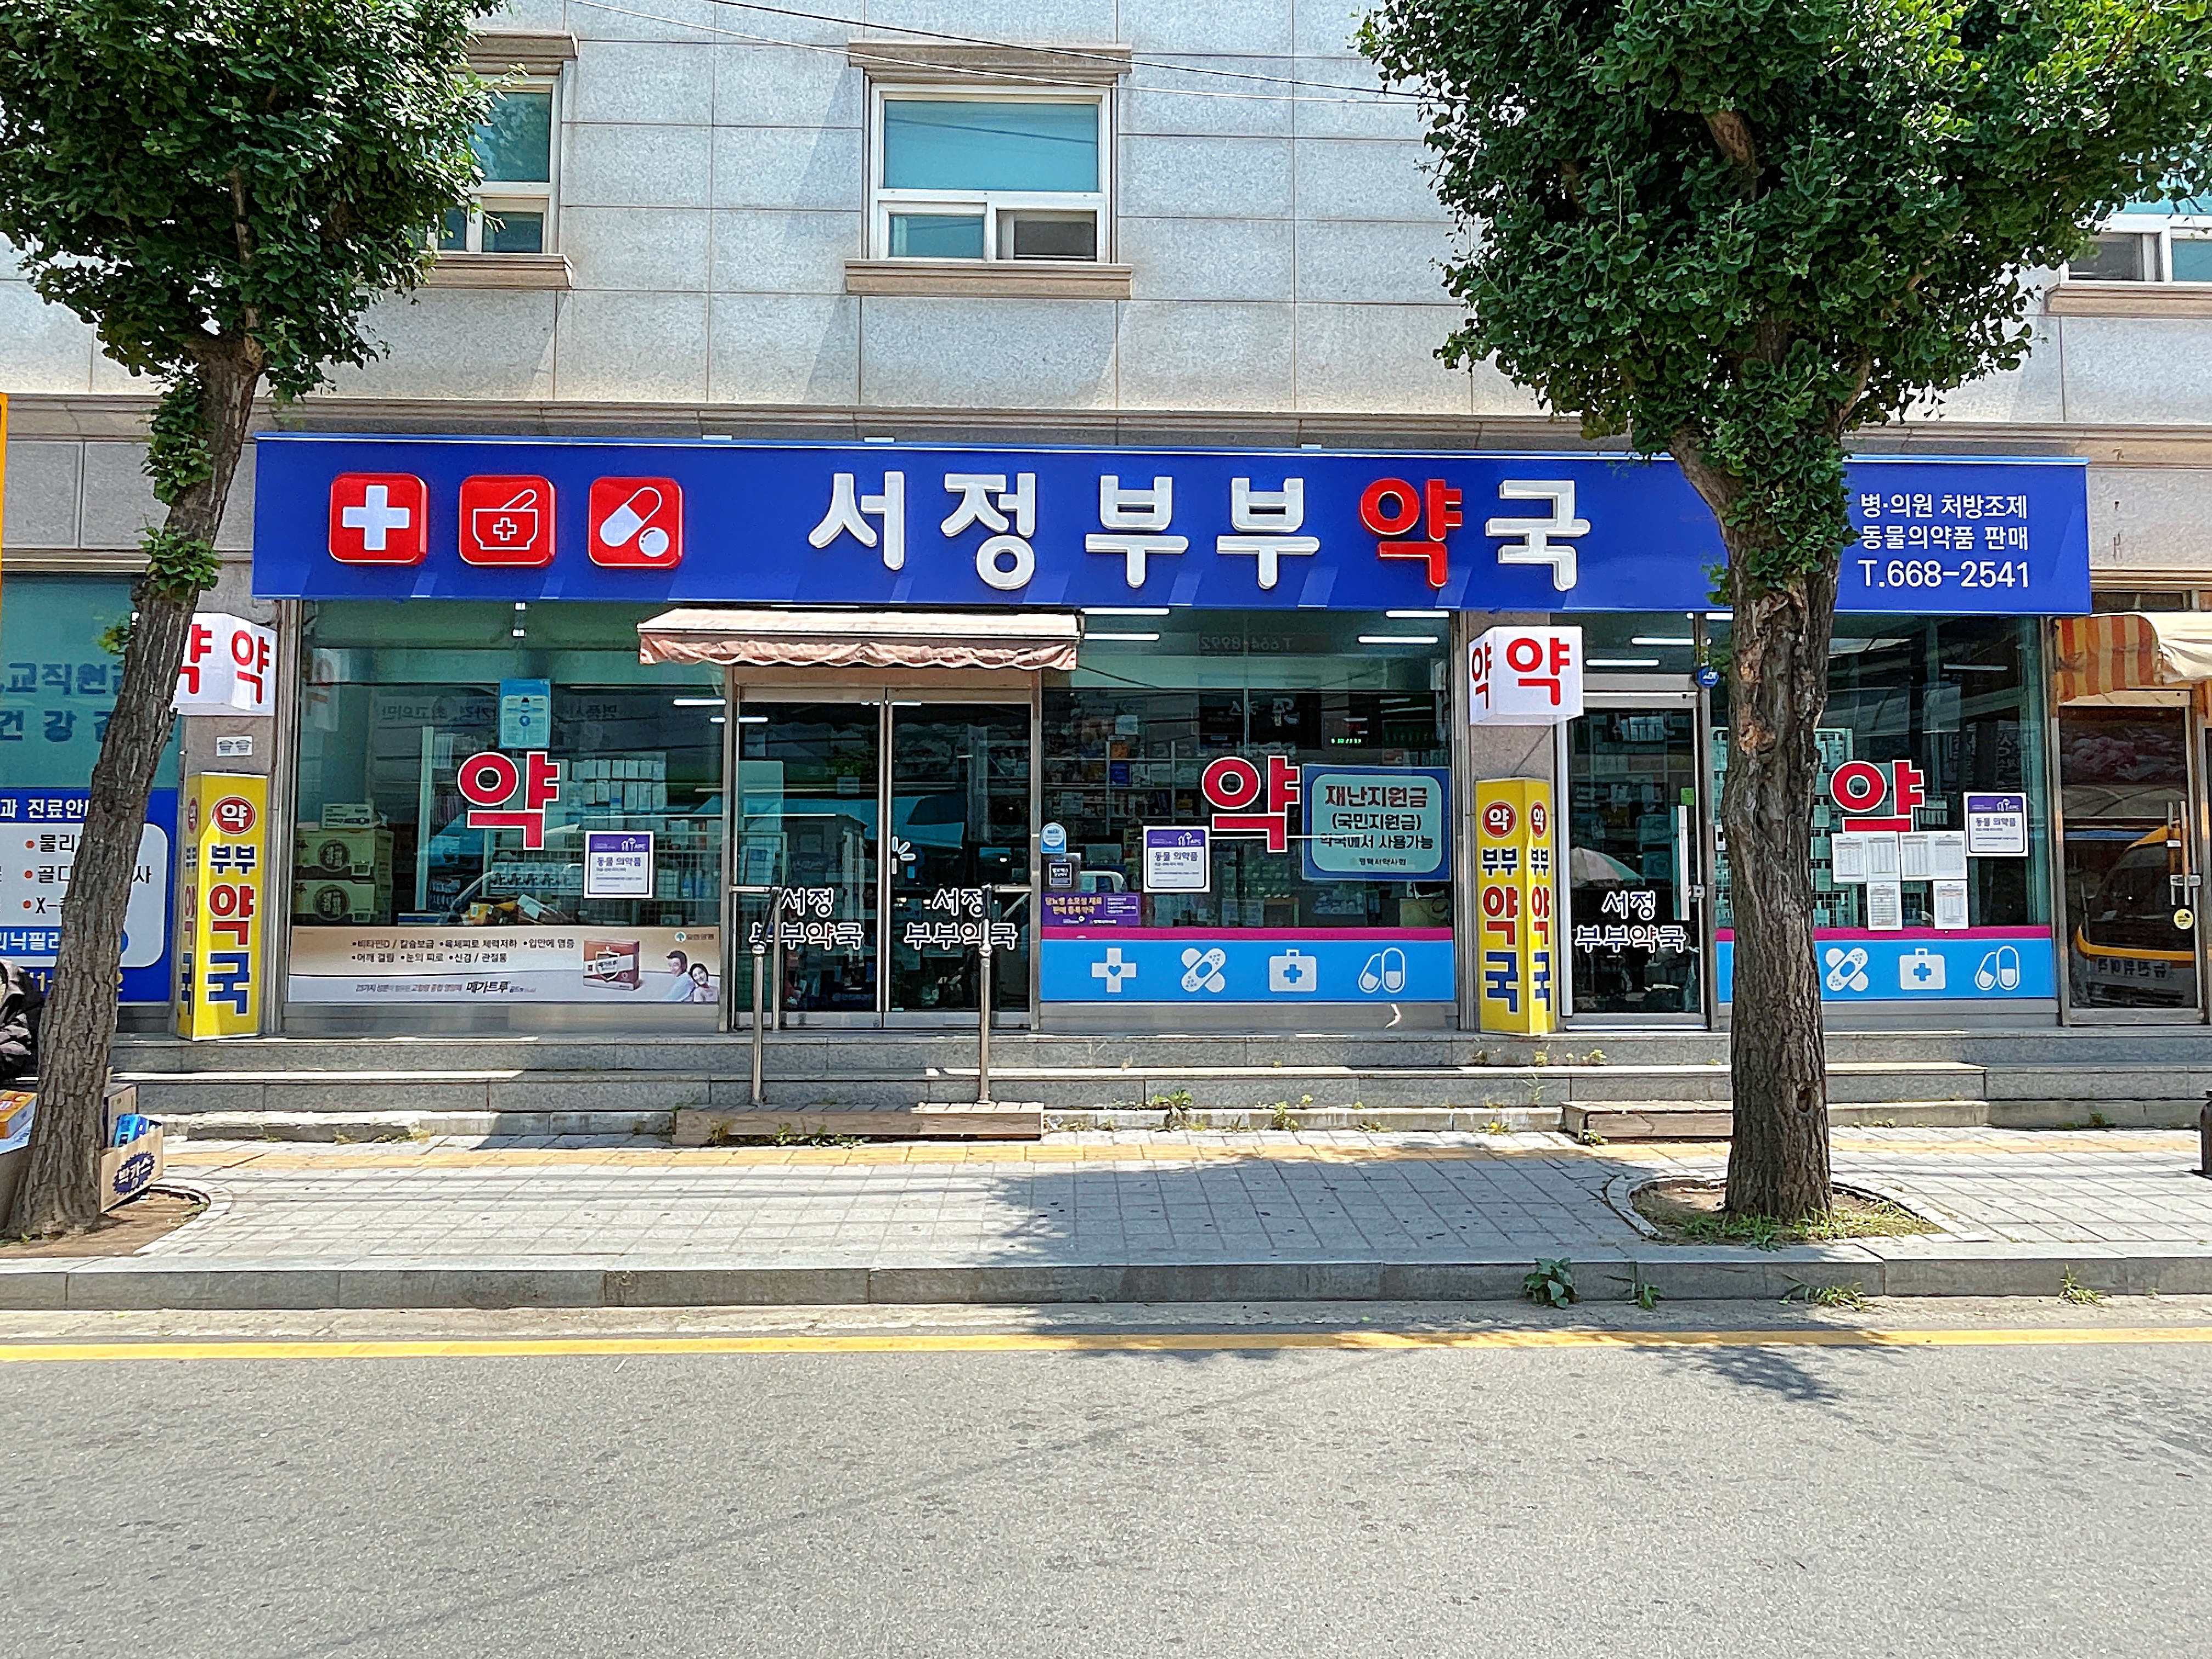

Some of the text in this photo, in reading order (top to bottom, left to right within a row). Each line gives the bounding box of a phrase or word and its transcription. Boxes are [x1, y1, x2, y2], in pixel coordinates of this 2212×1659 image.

[1861, 493, 2027, 520] 병·의원 처방조제
[1861, 525, 2029, 551] 동물의약품 판매
[1858, 560, 2029, 588] T.668-2541
[232, 630, 270, 704] 약
[1471, 641, 1492, 709] 약
[1505, 637, 1570, 706] 약
[458, 751, 560, 850] 약
[1201, 755, 1300, 853] 약
[1324, 785, 1428, 808] 재난지원금
[1830, 759, 1925, 833] 약
[221, 804, 248, 828] 약
[1331, 812, 1422, 831] (국민지원금)
[1488, 808, 1510, 831] 약
[1533, 808, 1545, 831] 약
[1319, 833, 1434, 849] 약국에서 사용가능
[210, 845, 256, 874] 부부
[1482, 848, 1518, 877] 부부
[1531, 848, 1549, 876] 부부
[781, 888, 834, 917] 서정
[932, 888, 985, 917] 서정
[1601, 890, 1656, 921] 서정
[748, 922, 864, 950] 부부약국
[904, 922, 1018, 950] 부부약국
[1575, 924, 1686, 954] 부부약국
